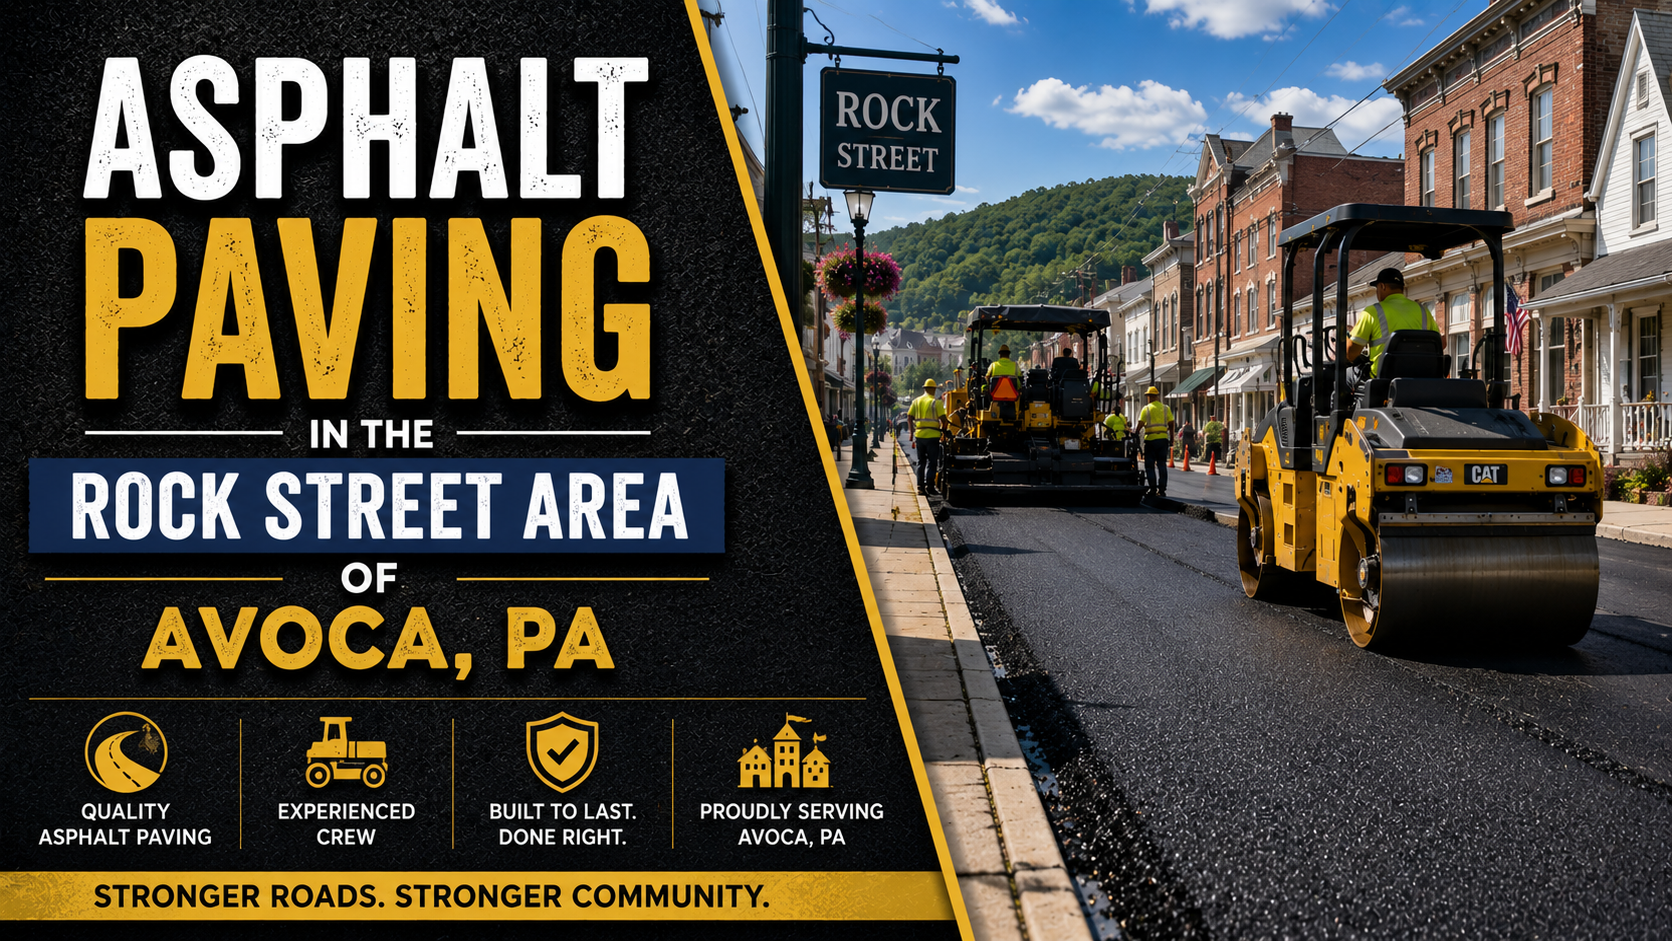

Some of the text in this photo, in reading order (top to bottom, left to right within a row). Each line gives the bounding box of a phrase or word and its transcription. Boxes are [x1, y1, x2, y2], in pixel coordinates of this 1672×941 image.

[837, 92, 941, 132] ROCK
[838, 143, 938, 172] STREET
[1472, 466, 1499, 483] CAT
